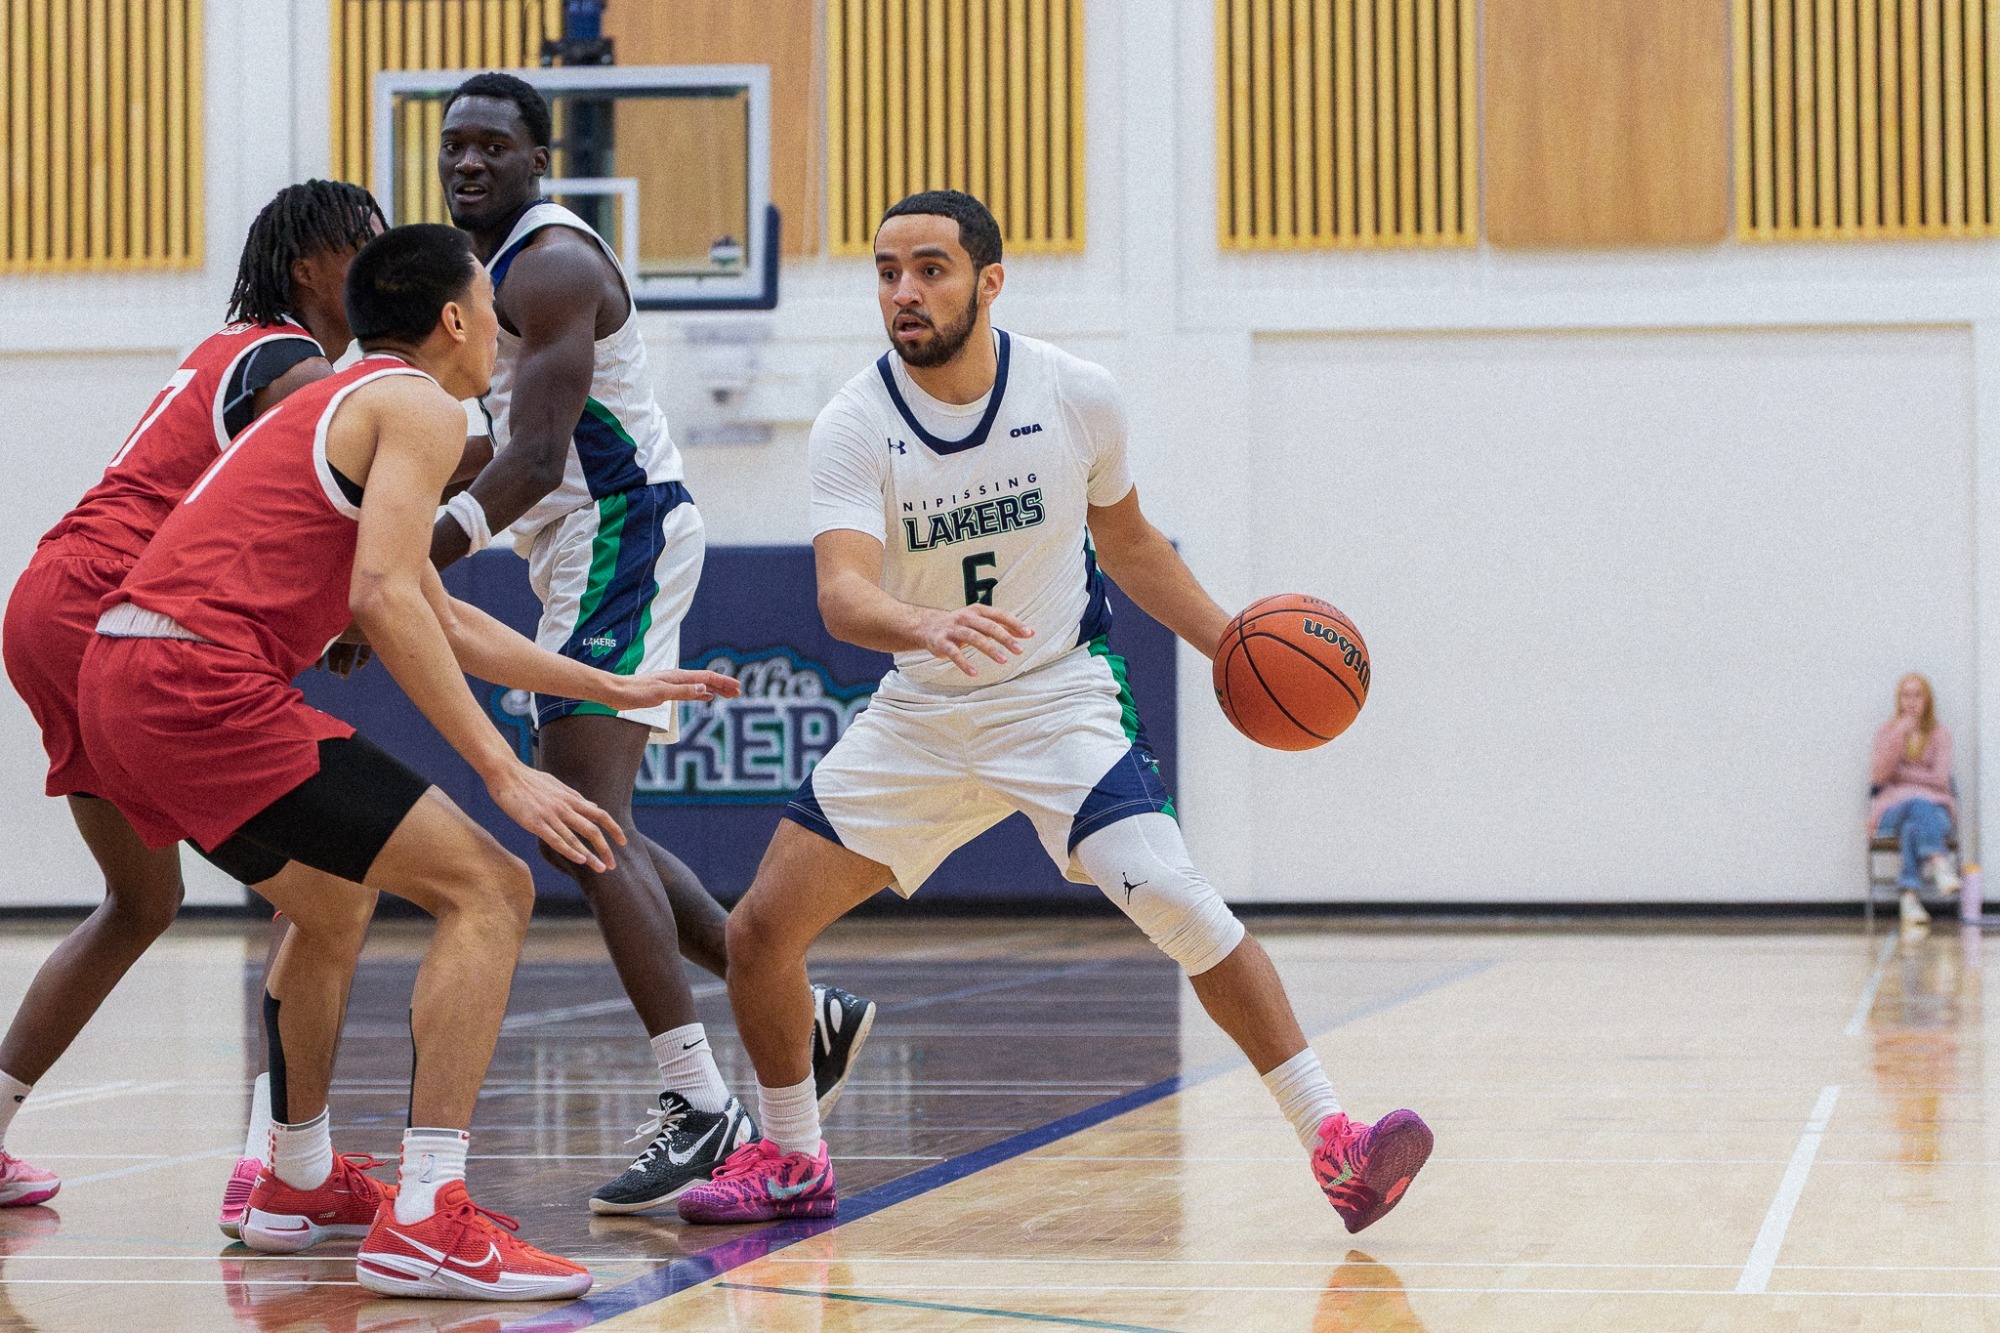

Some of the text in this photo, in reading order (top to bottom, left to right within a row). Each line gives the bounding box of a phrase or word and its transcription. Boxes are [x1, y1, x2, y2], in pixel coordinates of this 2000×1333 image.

[1009, 423, 1043, 439] OUA
[903, 472, 1038, 512] NIPISSING
[902, 487, 1046, 552] LAKERS
[961, 551, 999, 607] 6
[582, 637, 617, 648] LAKERS
